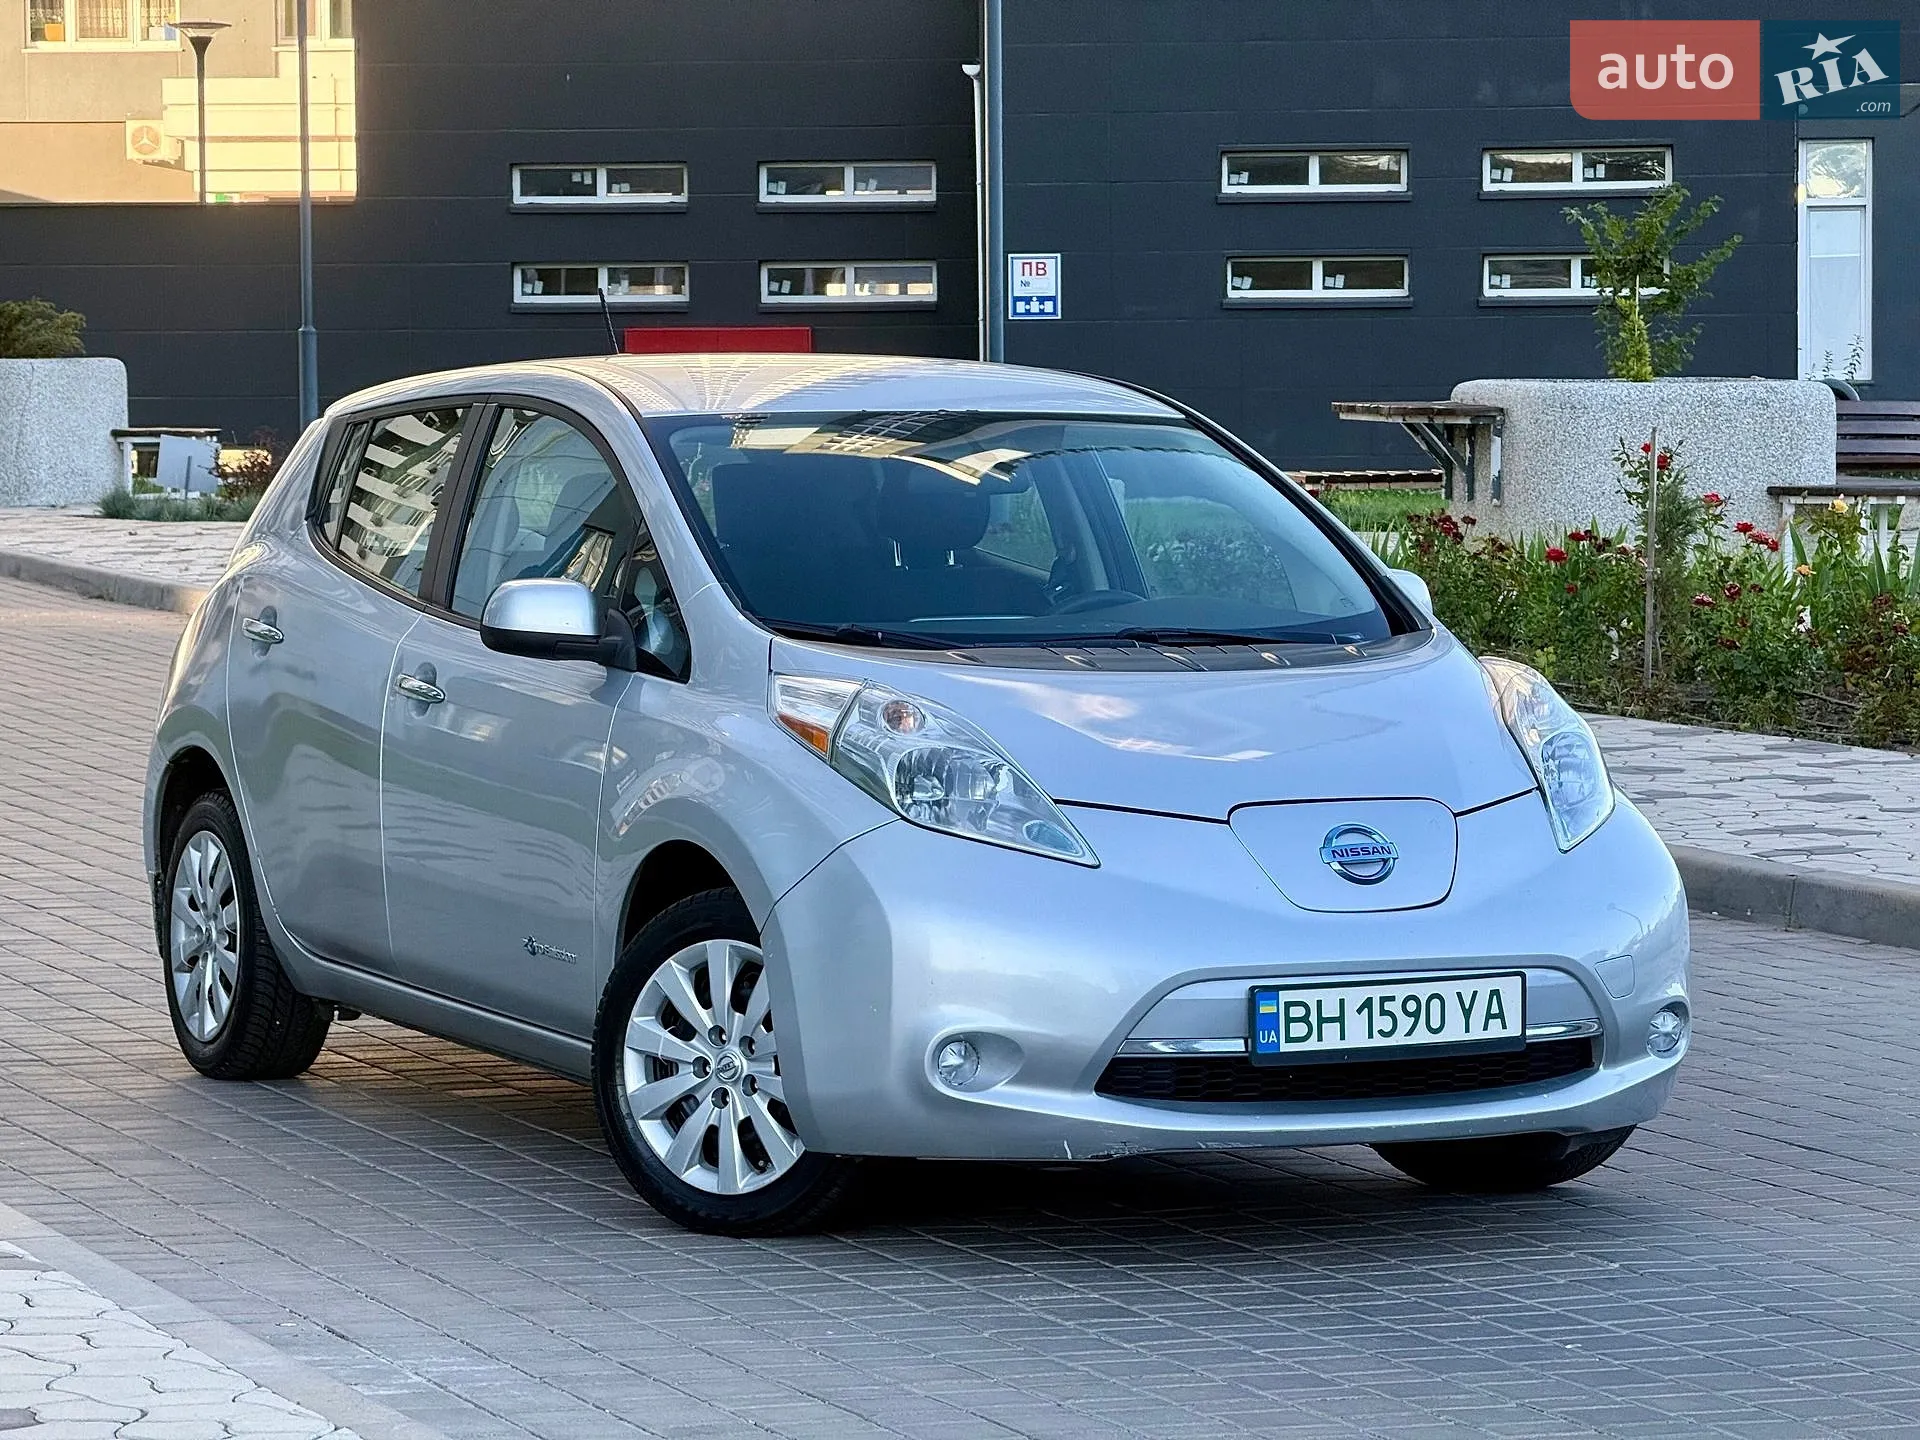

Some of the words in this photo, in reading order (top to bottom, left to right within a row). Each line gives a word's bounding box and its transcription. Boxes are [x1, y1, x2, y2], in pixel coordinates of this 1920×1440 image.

[1021, 261, 1047, 276] ПВ
[1331, 845, 1392, 858] NISSAN
[1283, 998, 1346, 1044] BH
[1355, 992, 1446, 1039] 1590
[1455, 988, 1508, 1034] YA
[1259, 1031, 1278, 1044] UA
